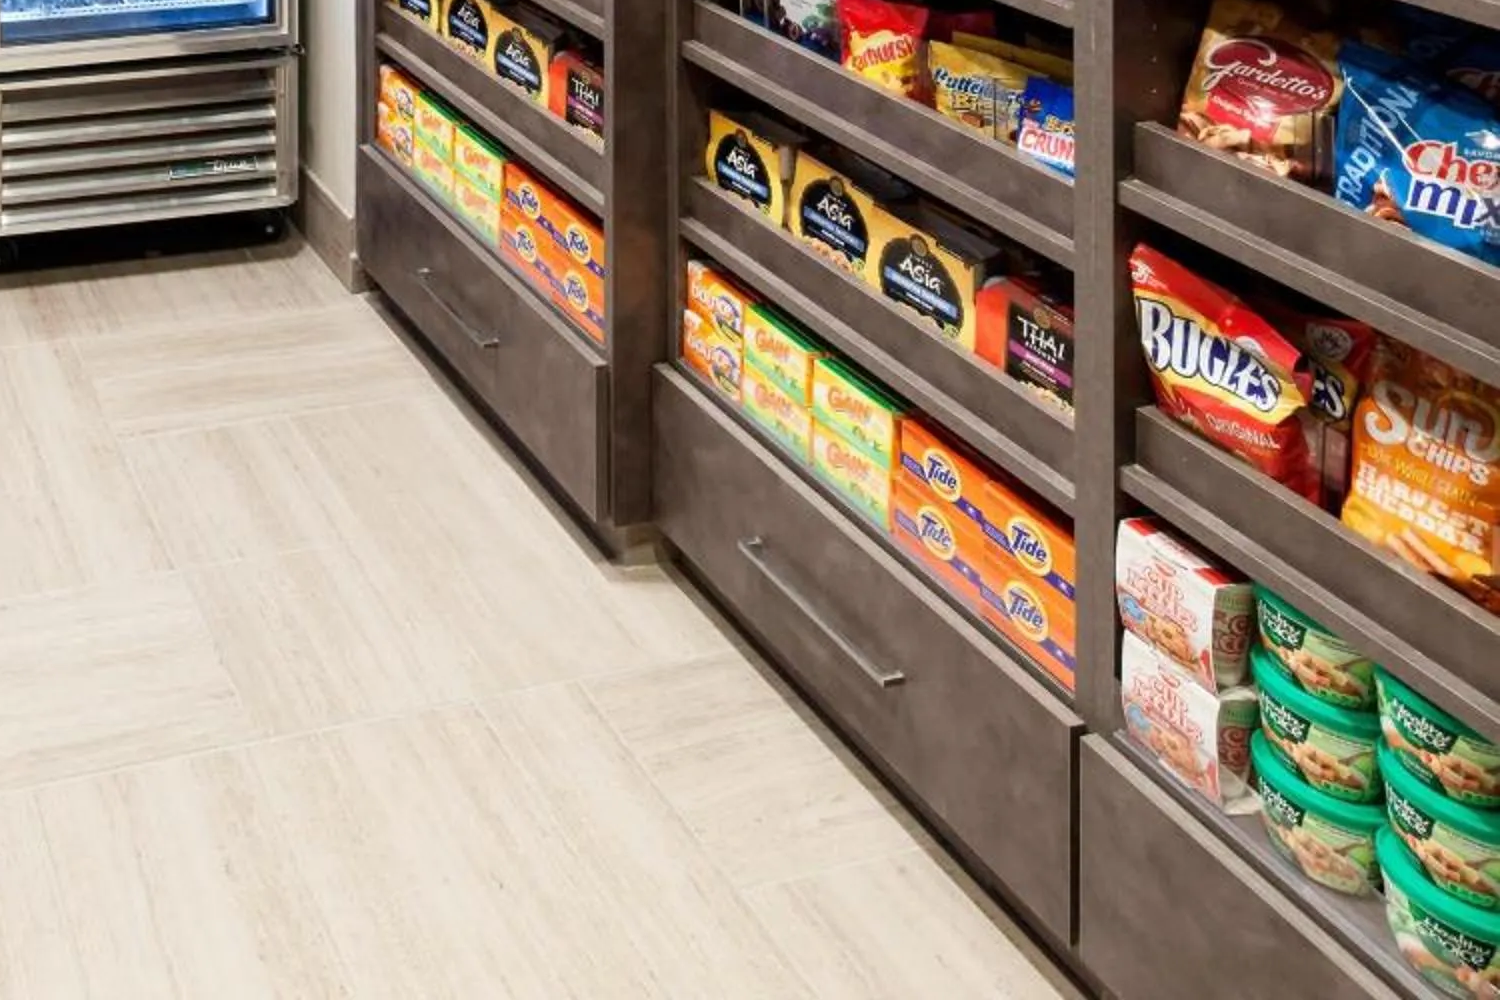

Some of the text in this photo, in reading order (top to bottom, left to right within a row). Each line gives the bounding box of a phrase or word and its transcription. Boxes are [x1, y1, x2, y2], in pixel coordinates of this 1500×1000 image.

[1201, 38, 1327, 101] Gardetto's
[1022, 128, 1074, 159] CRUN
[1404, 139, 1500, 192] Che
[1016, 314, 1065, 361] THAI
[1138, 297, 1282, 412] BUGLES
[1364, 379, 1500, 462] Sun
[927, 456, 958, 490] Tide
[1407, 436, 1490, 487] CHIPS
[921, 513, 950, 547] Tide
[1011, 525, 1047, 563] Tide
[1008, 589, 1044, 629] Tide
